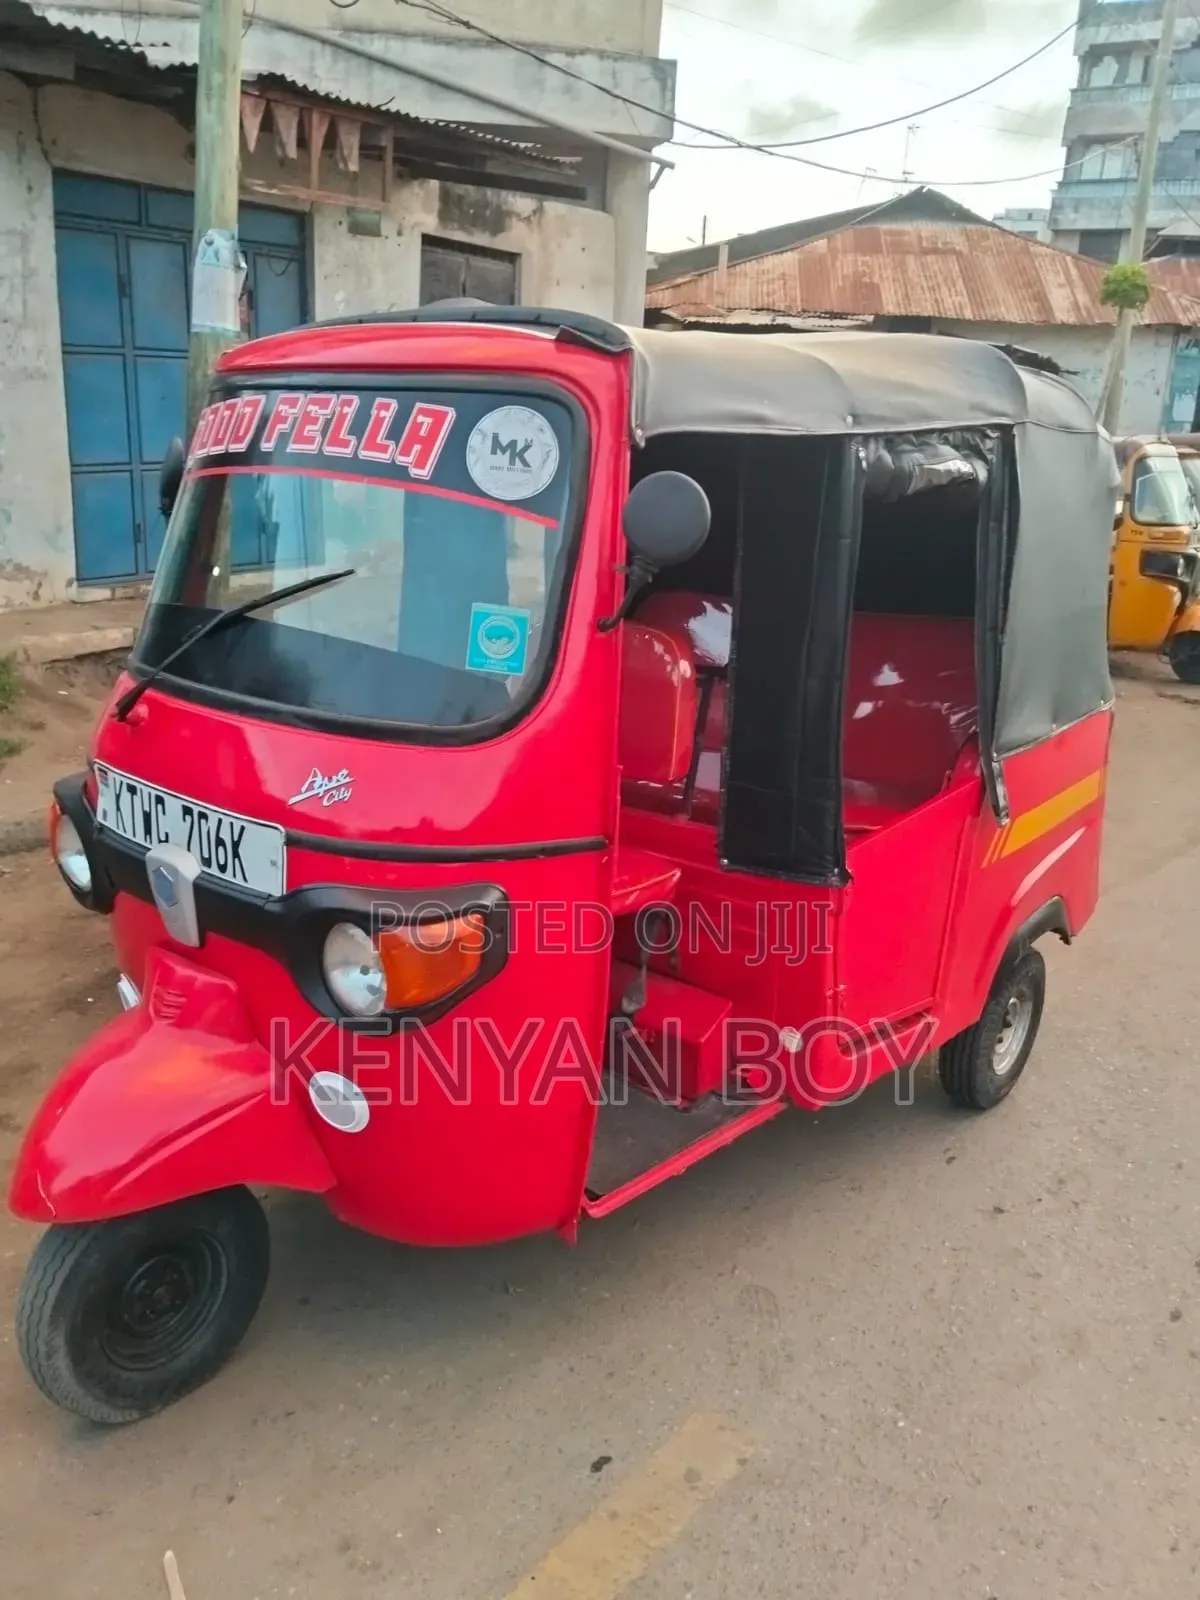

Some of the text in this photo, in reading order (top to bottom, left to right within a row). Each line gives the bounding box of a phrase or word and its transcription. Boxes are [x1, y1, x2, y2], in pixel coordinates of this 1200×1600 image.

[261, 393, 456, 480] FELLA
[490, 432, 533, 468] MK
[113, 775, 249, 883] KTWC 706K
